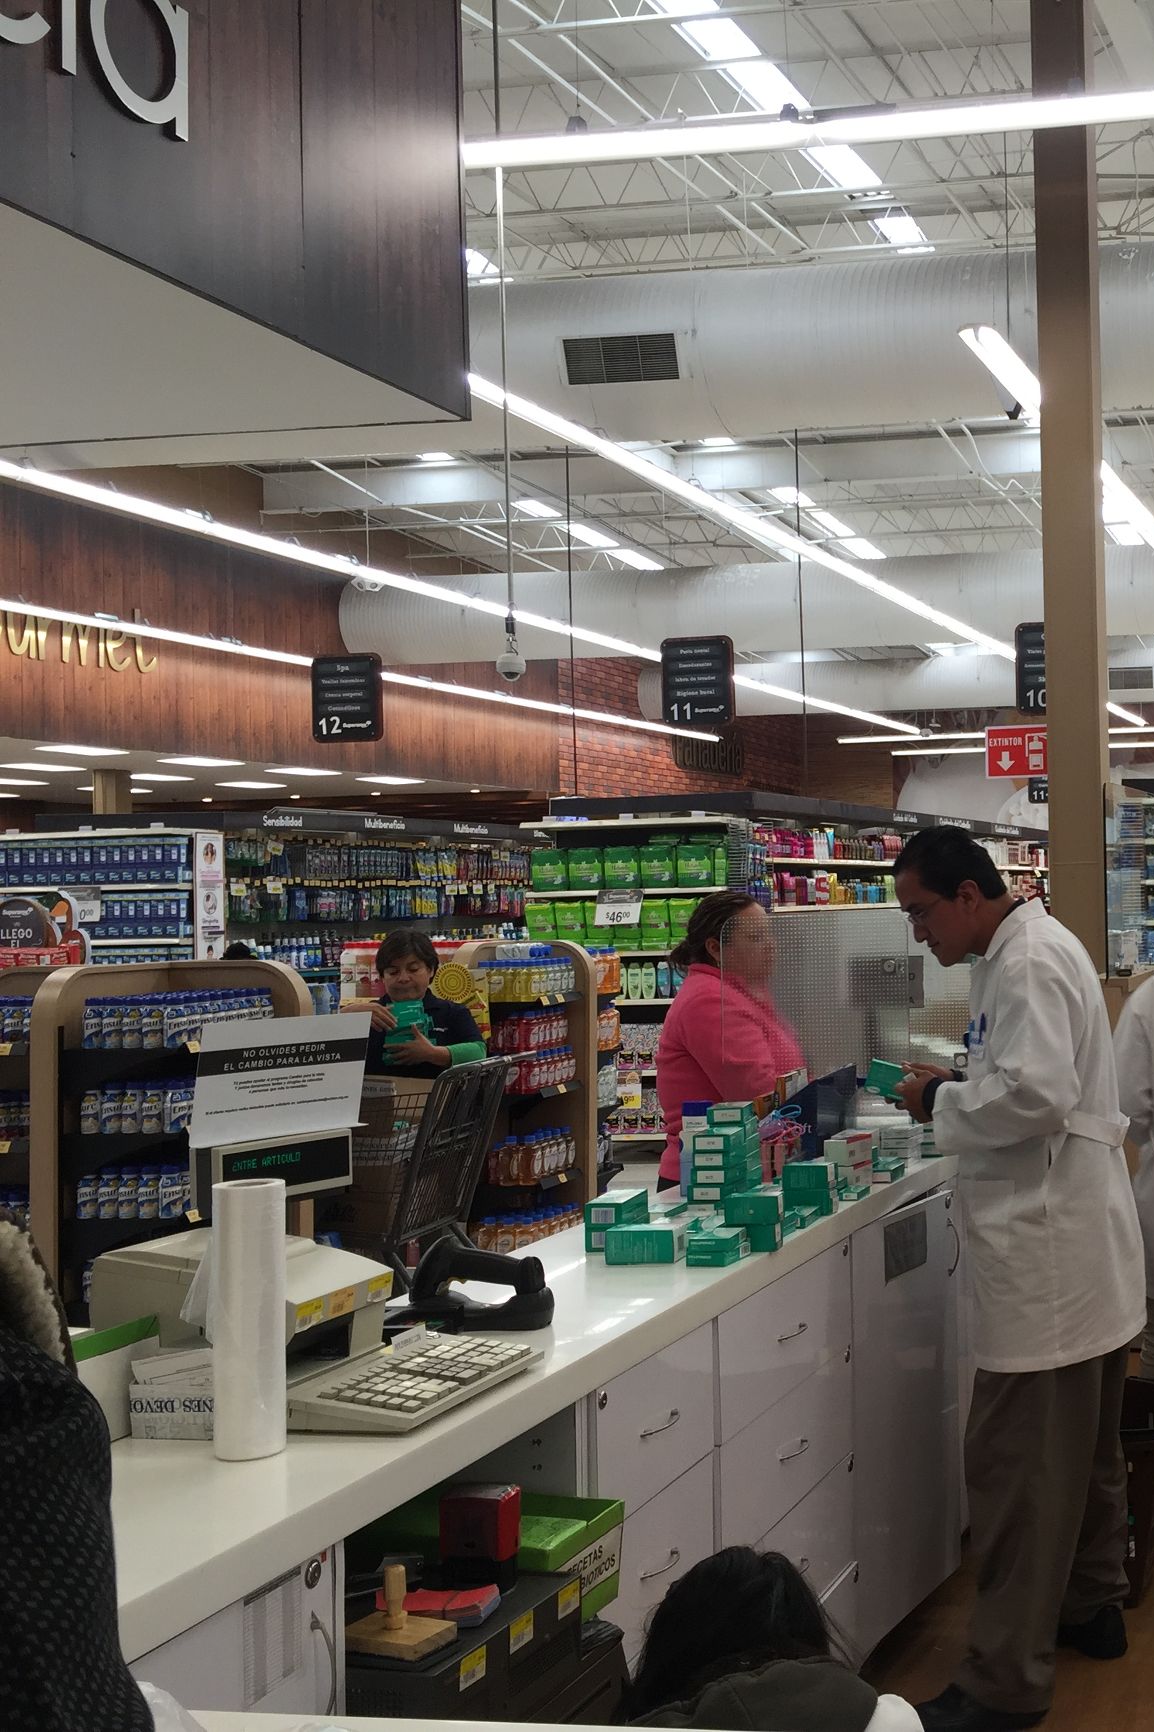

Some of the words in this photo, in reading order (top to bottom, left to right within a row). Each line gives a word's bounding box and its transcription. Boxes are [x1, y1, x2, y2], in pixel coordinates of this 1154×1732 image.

[336, 664, 350, 672] Spa
[670, 702, 692, 720] 11
[318, 716, 342, 735] 12
[989, 736, 1023, 747] EXTINTOR
[263, 815, 303, 827] Sensibilidad
[364, 818, 406, 830] Multibeneficio
[0, 929, 33, 940] LLEGO
[243, 1048, 256, 1058] NO
[258, 1046, 297, 1057] OLVIDES
[299, 1043, 326, 1053] PEDIR
[223, 1062, 235, 1071] EL
[238, 1058, 274, 1070] CAMBIO
[276, 1056, 300, 1066] PARA
[302, 1054, 314, 1063] LA
[316, 1052, 342, 1062] VISTA
[232, 1158, 258, 1172] ENTRE
[261, 1151, 301, 1166] ARTICULO
